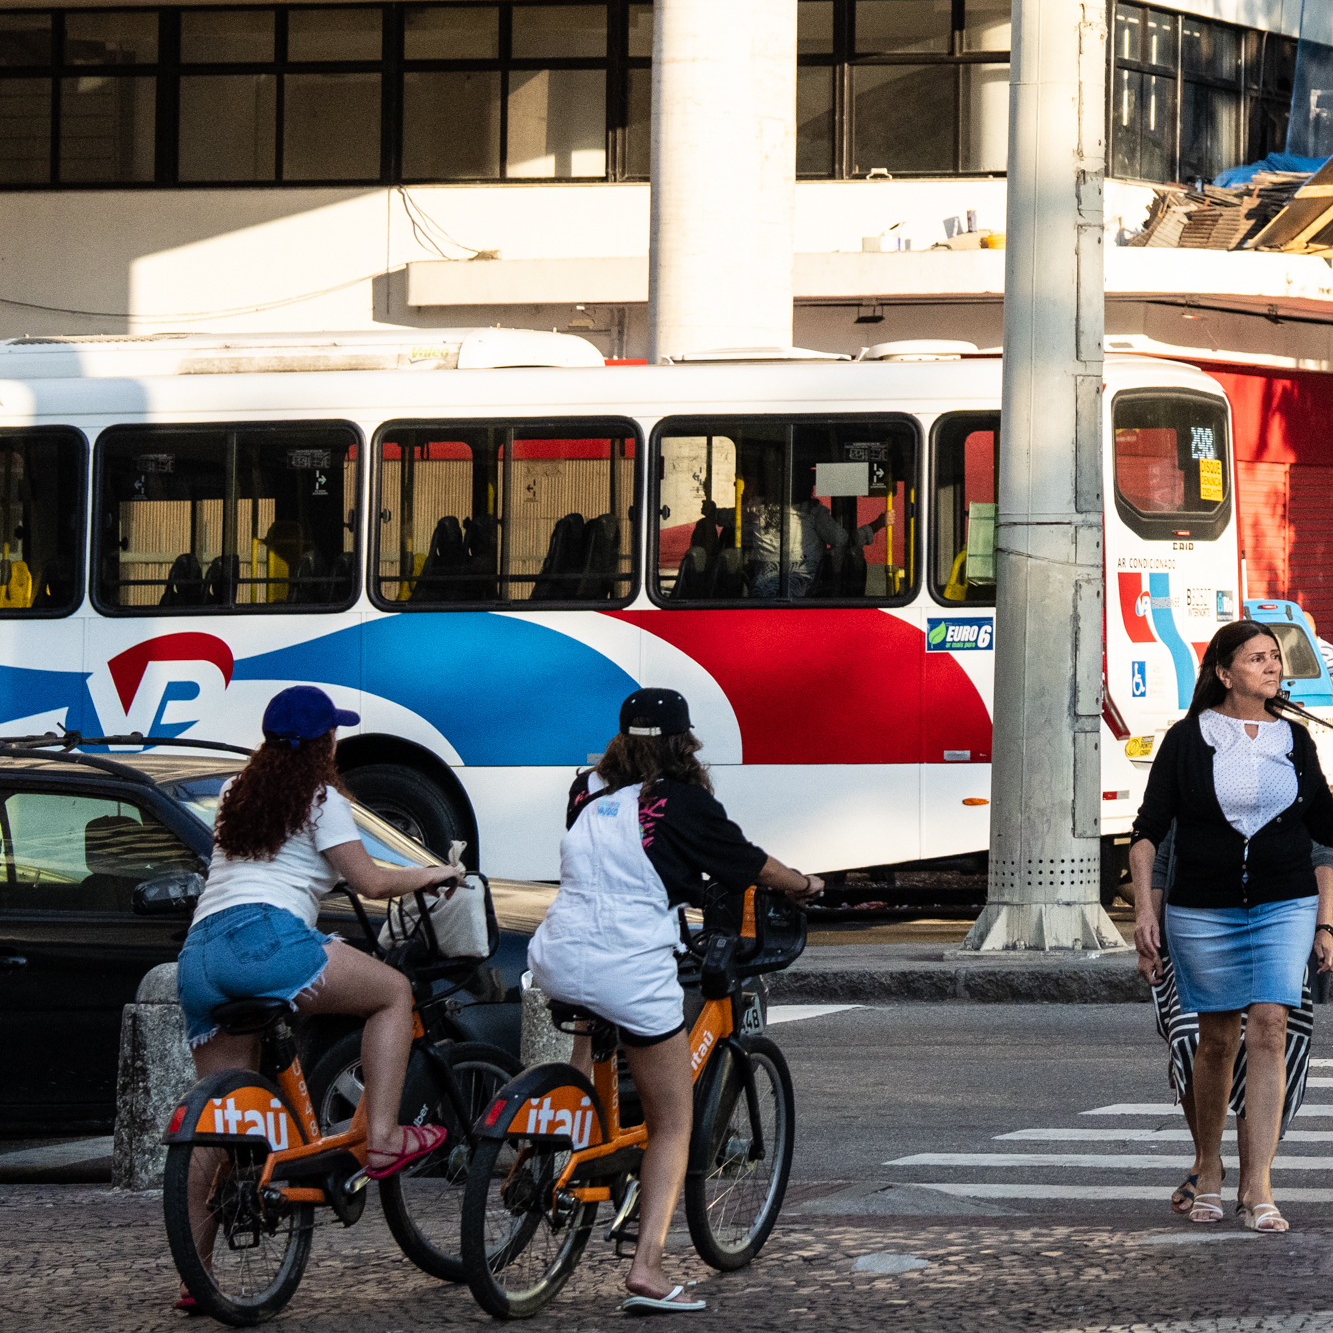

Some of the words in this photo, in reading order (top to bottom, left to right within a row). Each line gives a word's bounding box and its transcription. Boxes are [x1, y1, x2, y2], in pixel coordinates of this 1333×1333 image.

[1117, 557, 1126, 568] AR
[1129, 557, 1177, 570] CONDICIONADO
[946, 625, 979, 642] EURO
[977, 625, 992, 648] 6
[691, 1030, 714, 1070] itaú
[212, 1096, 289, 1151] itaú
[527, 1095, 593, 1150] itaú
